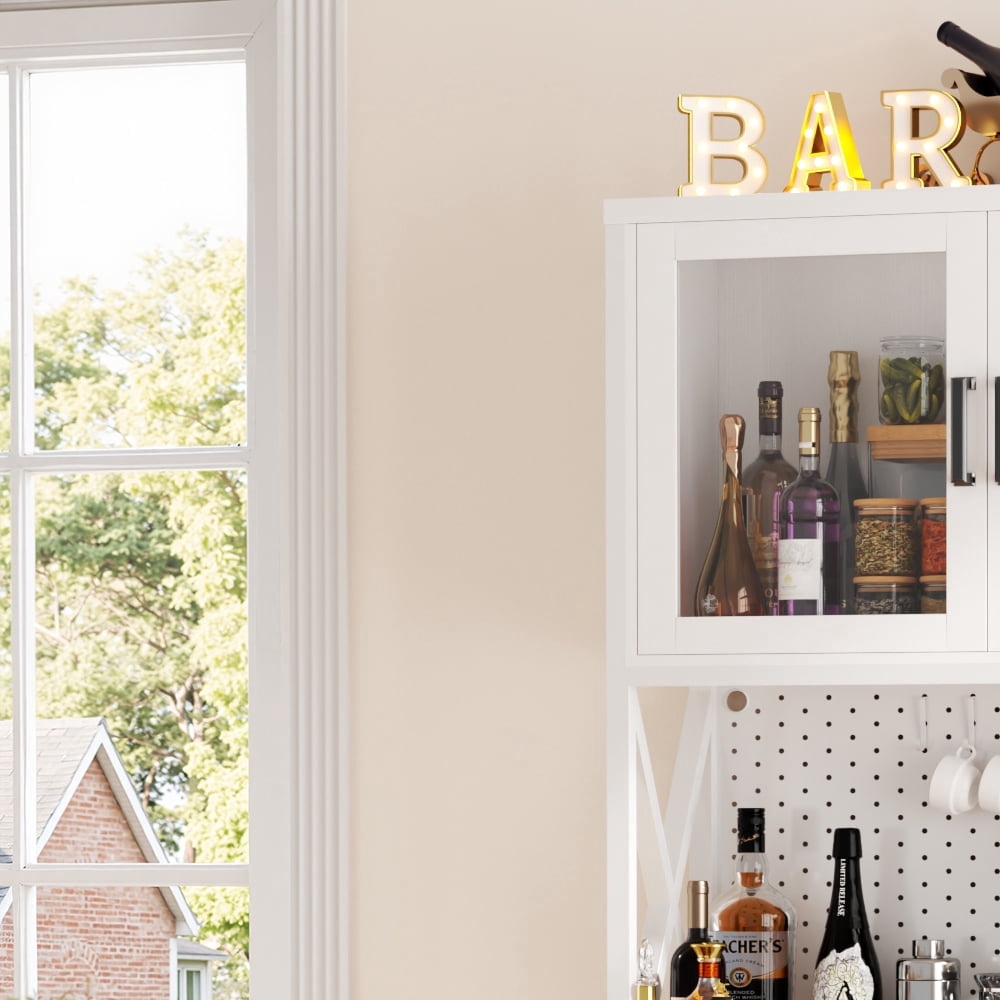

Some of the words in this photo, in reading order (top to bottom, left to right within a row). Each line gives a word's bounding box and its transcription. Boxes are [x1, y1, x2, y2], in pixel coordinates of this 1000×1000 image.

[678, 89, 973, 198] BAR
[839, 858, 847, 887] LIMITED
[836, 887, 847, 917] RELEASE
[714, 938, 783, 954] ACHER'S
